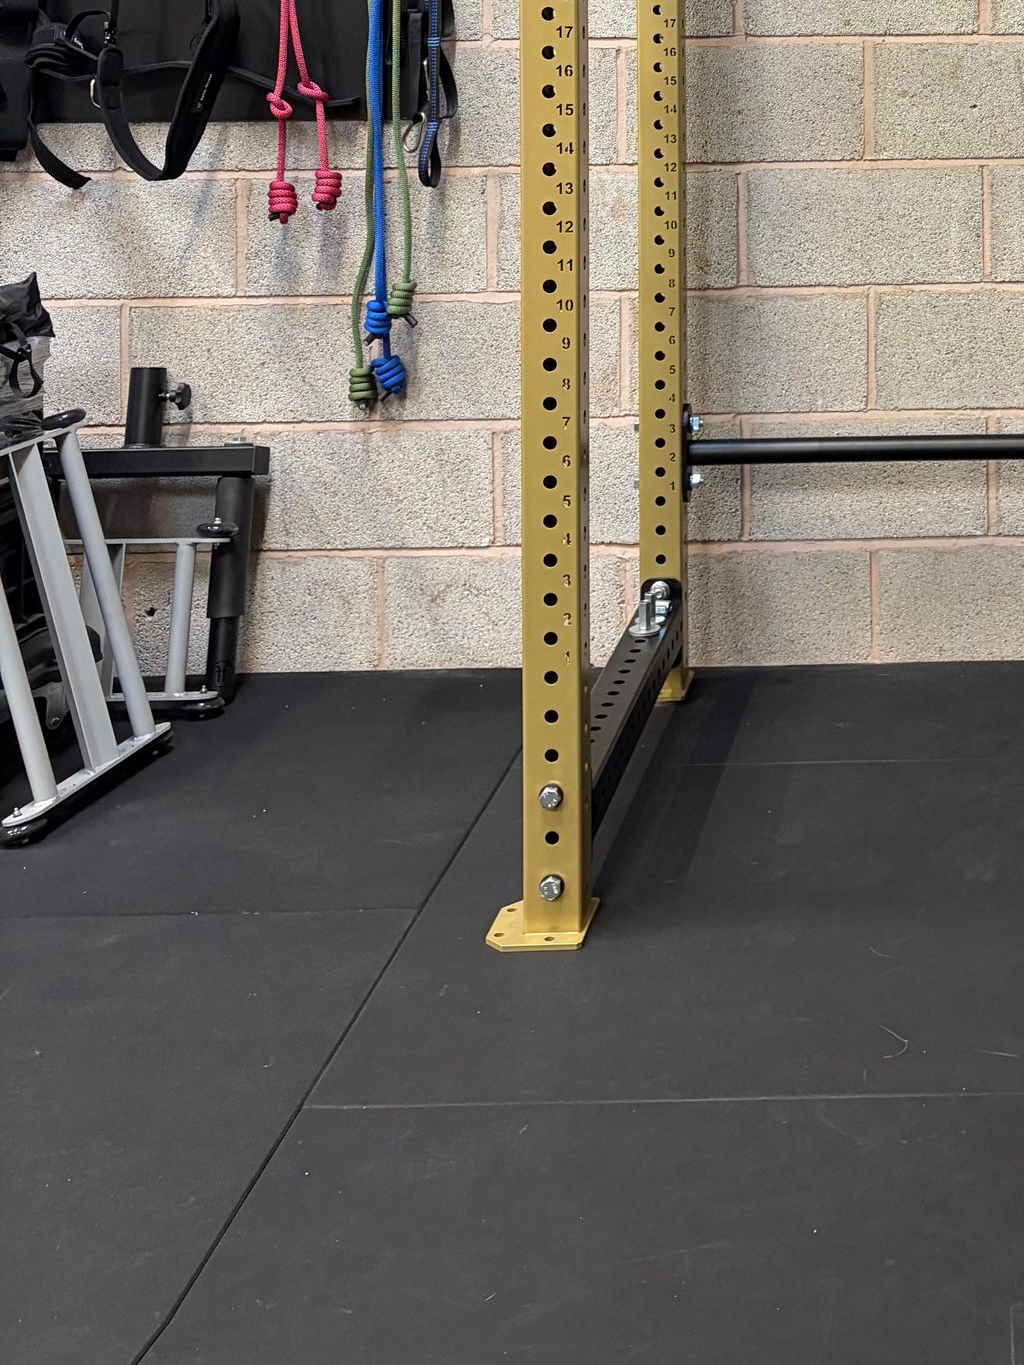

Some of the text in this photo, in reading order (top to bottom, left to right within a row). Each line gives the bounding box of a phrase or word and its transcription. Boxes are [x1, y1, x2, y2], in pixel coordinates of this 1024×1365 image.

[555, 25, 574, 39] 17
[555, 64, 574, 78] 16
[555, 103, 574, 117] 15
[555, 141, 575, 155] 14
[555, 181, 574, 195] 13
[555, 220, 574, 234] 12
[556, 258, 574, 272] 11
[555, 298, 574, 312] 10
[561, 336, 571, 350] 9
[561, 377, 571, 391] 8
[561, 416, 572, 430] 7
[561, 454, 572, 468] 6
[561, 494, 572, 507] 5
[561, 532, 572, 546] 4
[561, 573, 572, 587] 3
[562, 612, 573, 626] 2
[563, 650, 571, 665] 1
